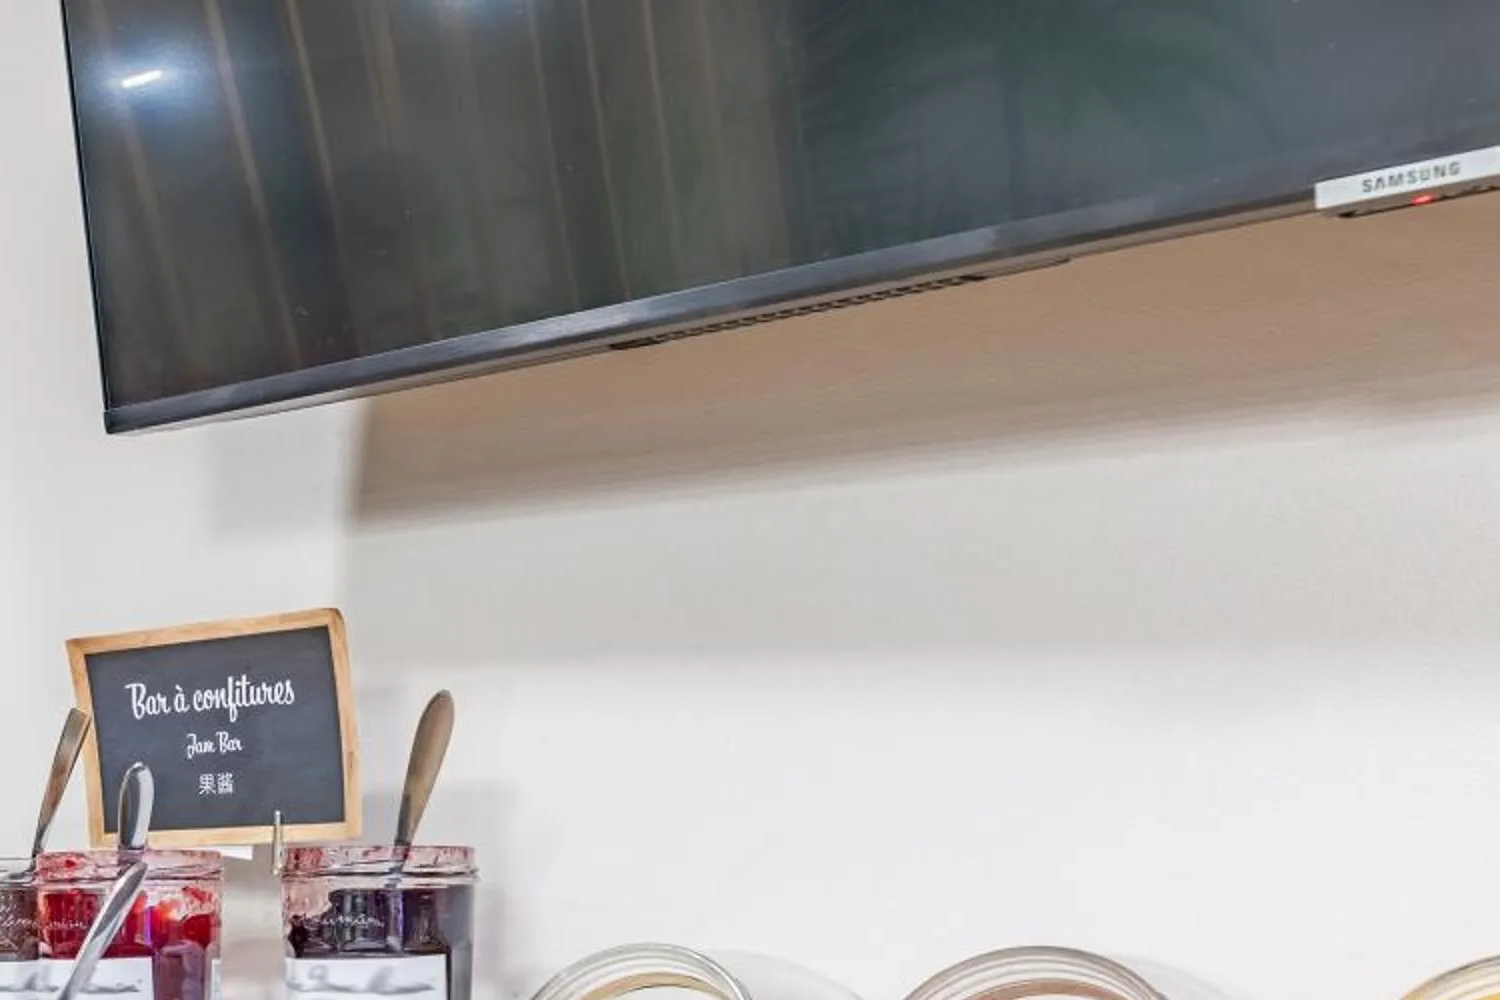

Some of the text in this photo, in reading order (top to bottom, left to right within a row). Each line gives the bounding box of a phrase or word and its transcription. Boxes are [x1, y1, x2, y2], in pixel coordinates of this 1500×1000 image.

[1362, 161, 1461, 193] SAMSUNG
[125, 674, 295, 722] Bar à confitures
[186, 731, 243, 760] Jam Bar
